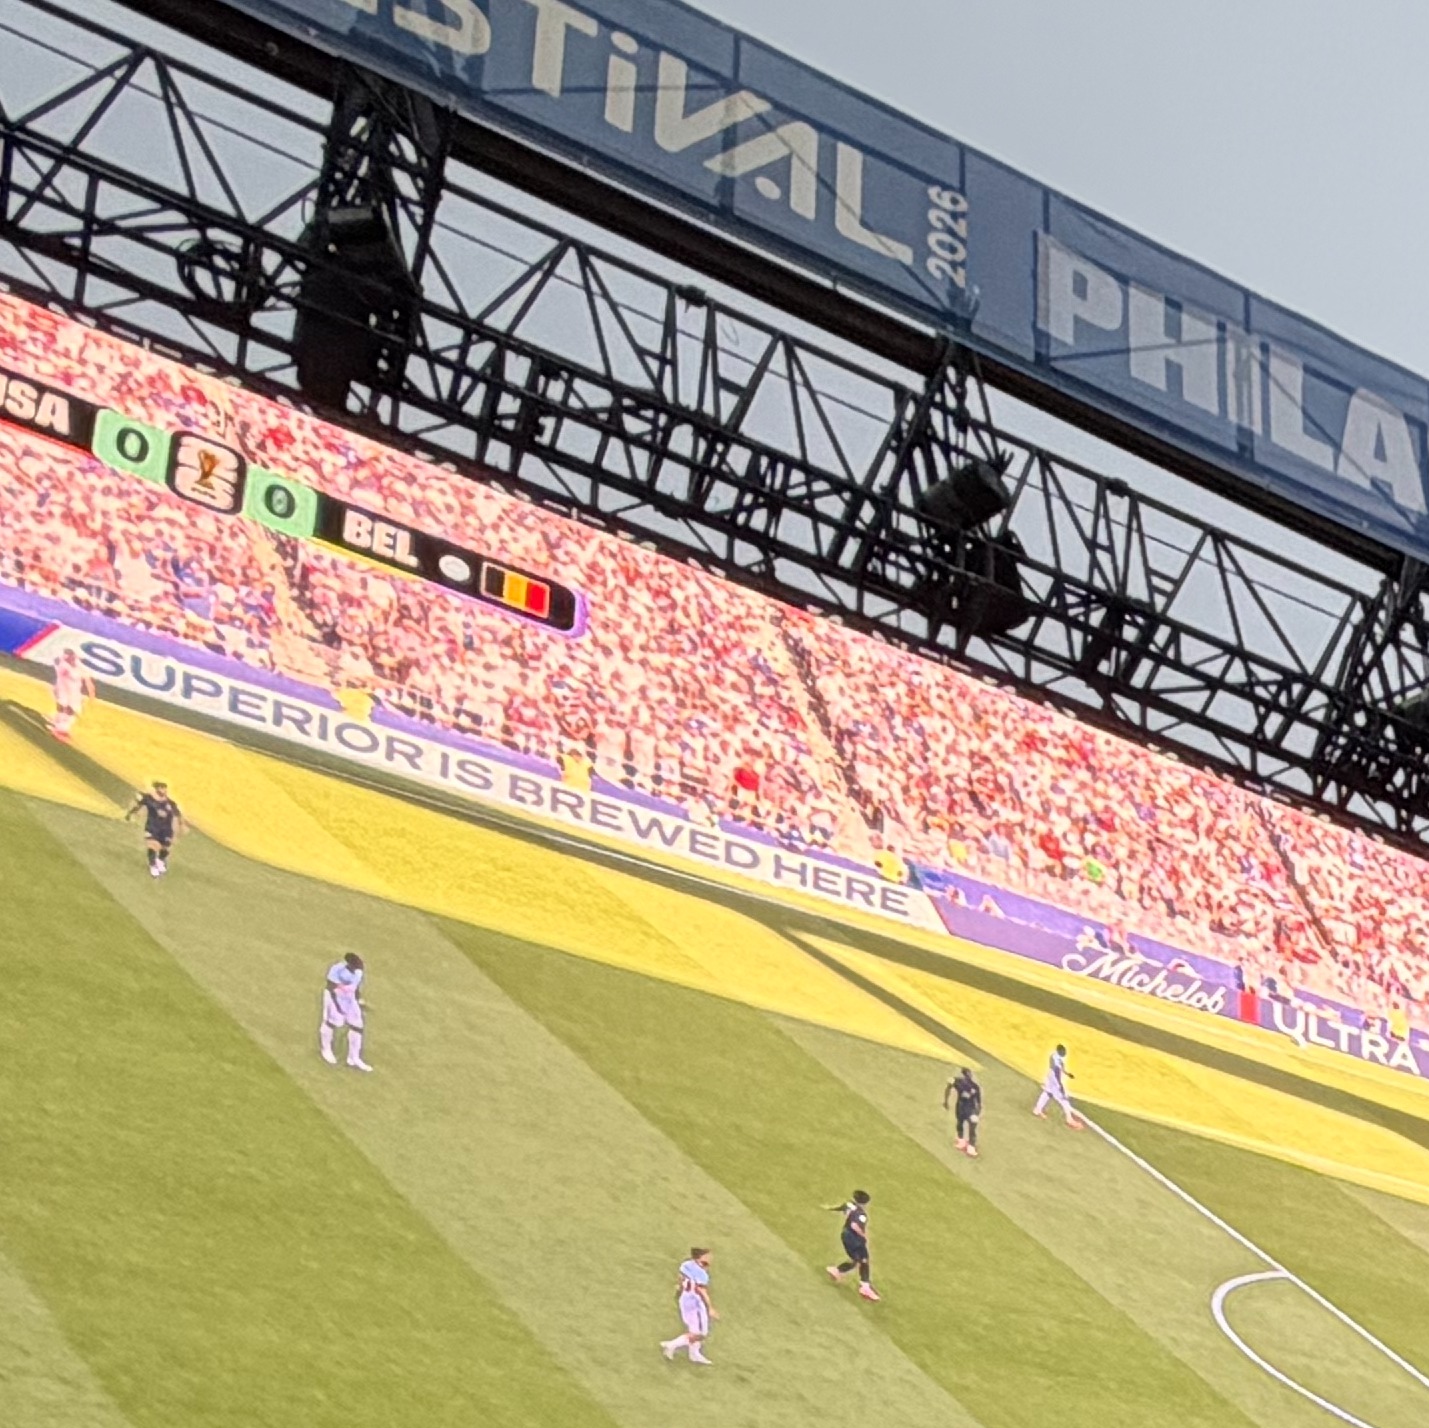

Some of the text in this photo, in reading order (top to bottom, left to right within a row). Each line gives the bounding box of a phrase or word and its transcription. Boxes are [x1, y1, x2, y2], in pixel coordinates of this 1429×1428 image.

[926, 185, 969, 289] 2026
[116, 426, 150, 464] 0
[264, 484, 296, 519] 0
[342, 513, 419, 570] BEL
[80, 640, 911, 917] SUPERIOR IS BREWED HERE
[1061, 942, 1421, 1075] Michelob ULTRA
